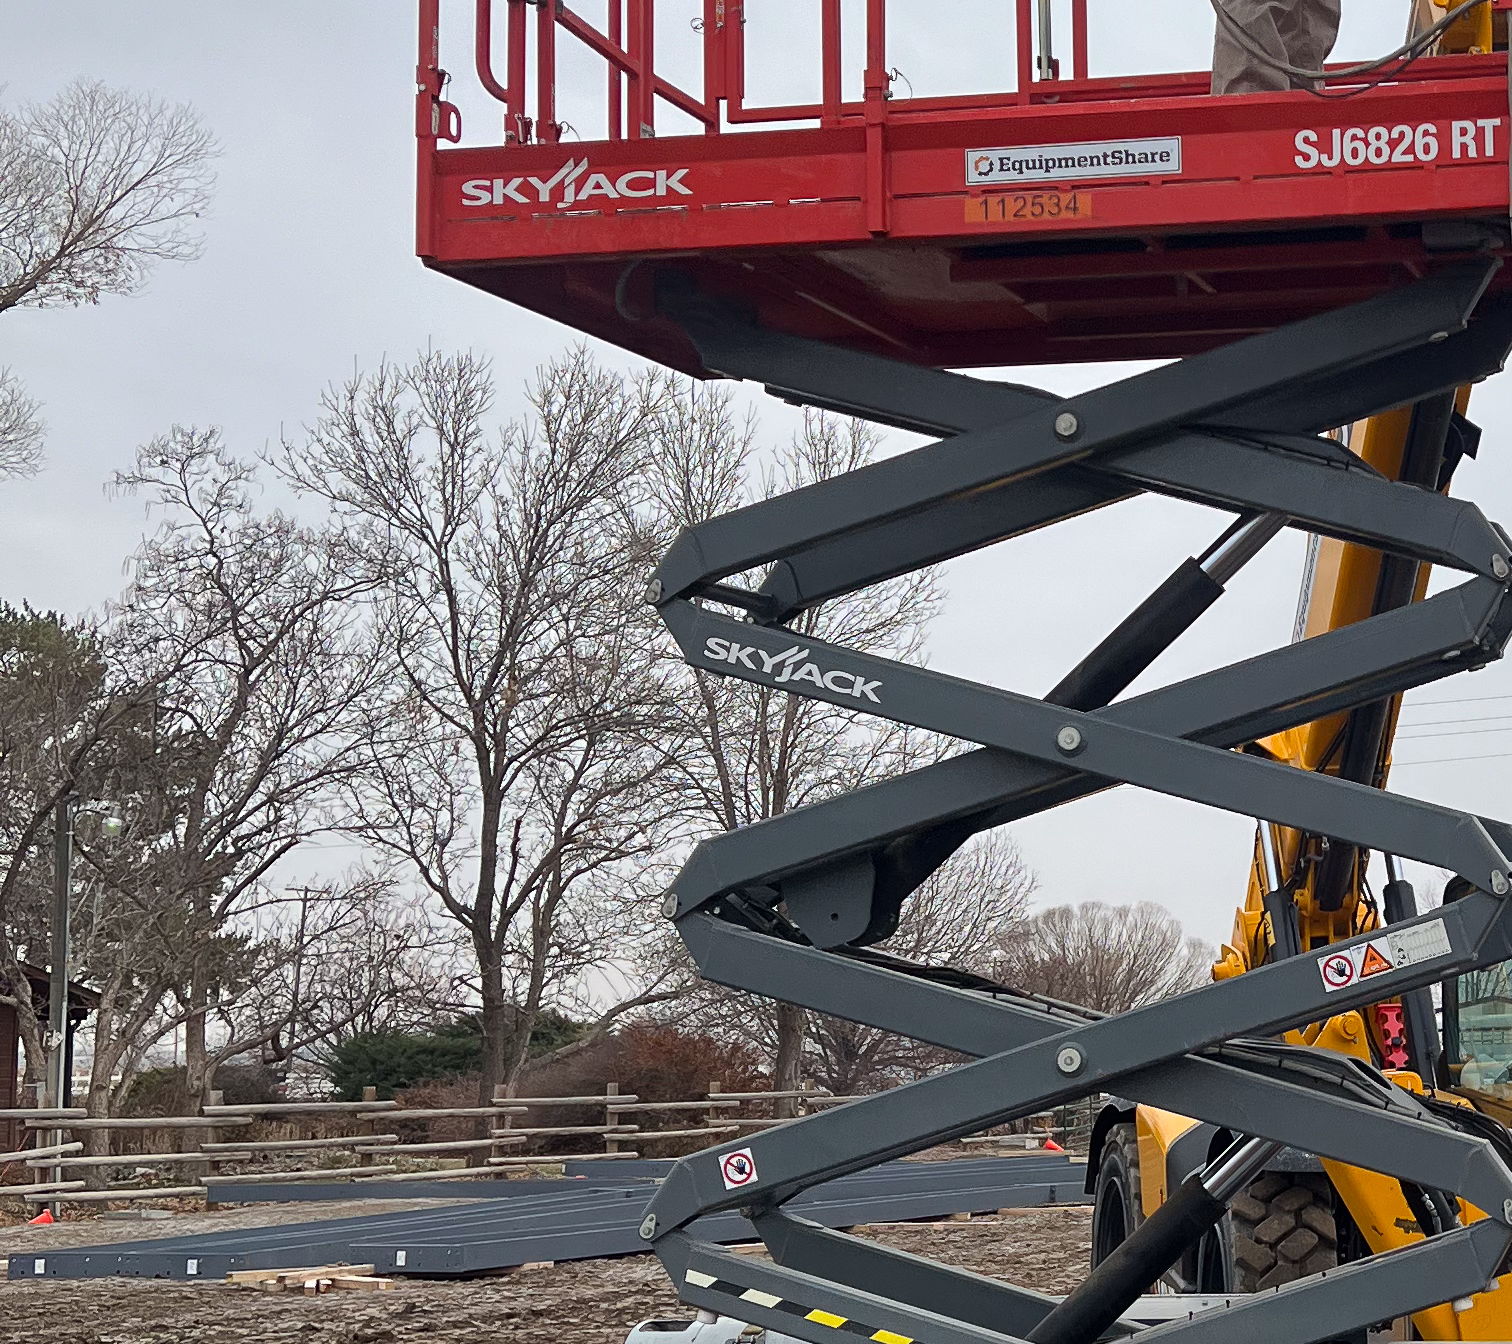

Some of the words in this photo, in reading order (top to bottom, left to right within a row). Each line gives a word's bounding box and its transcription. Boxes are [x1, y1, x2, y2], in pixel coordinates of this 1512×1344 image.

[998, 149, 1172, 175] EquipmentShare
[1294, 121, 1439, 169] SJ6826
[1451, 118, 1501, 159] RT
[460, 156, 691, 209] SKYJACK
[980, 192, 1080, 222] 112534
[703, 637, 882, 704] SKYJACK
